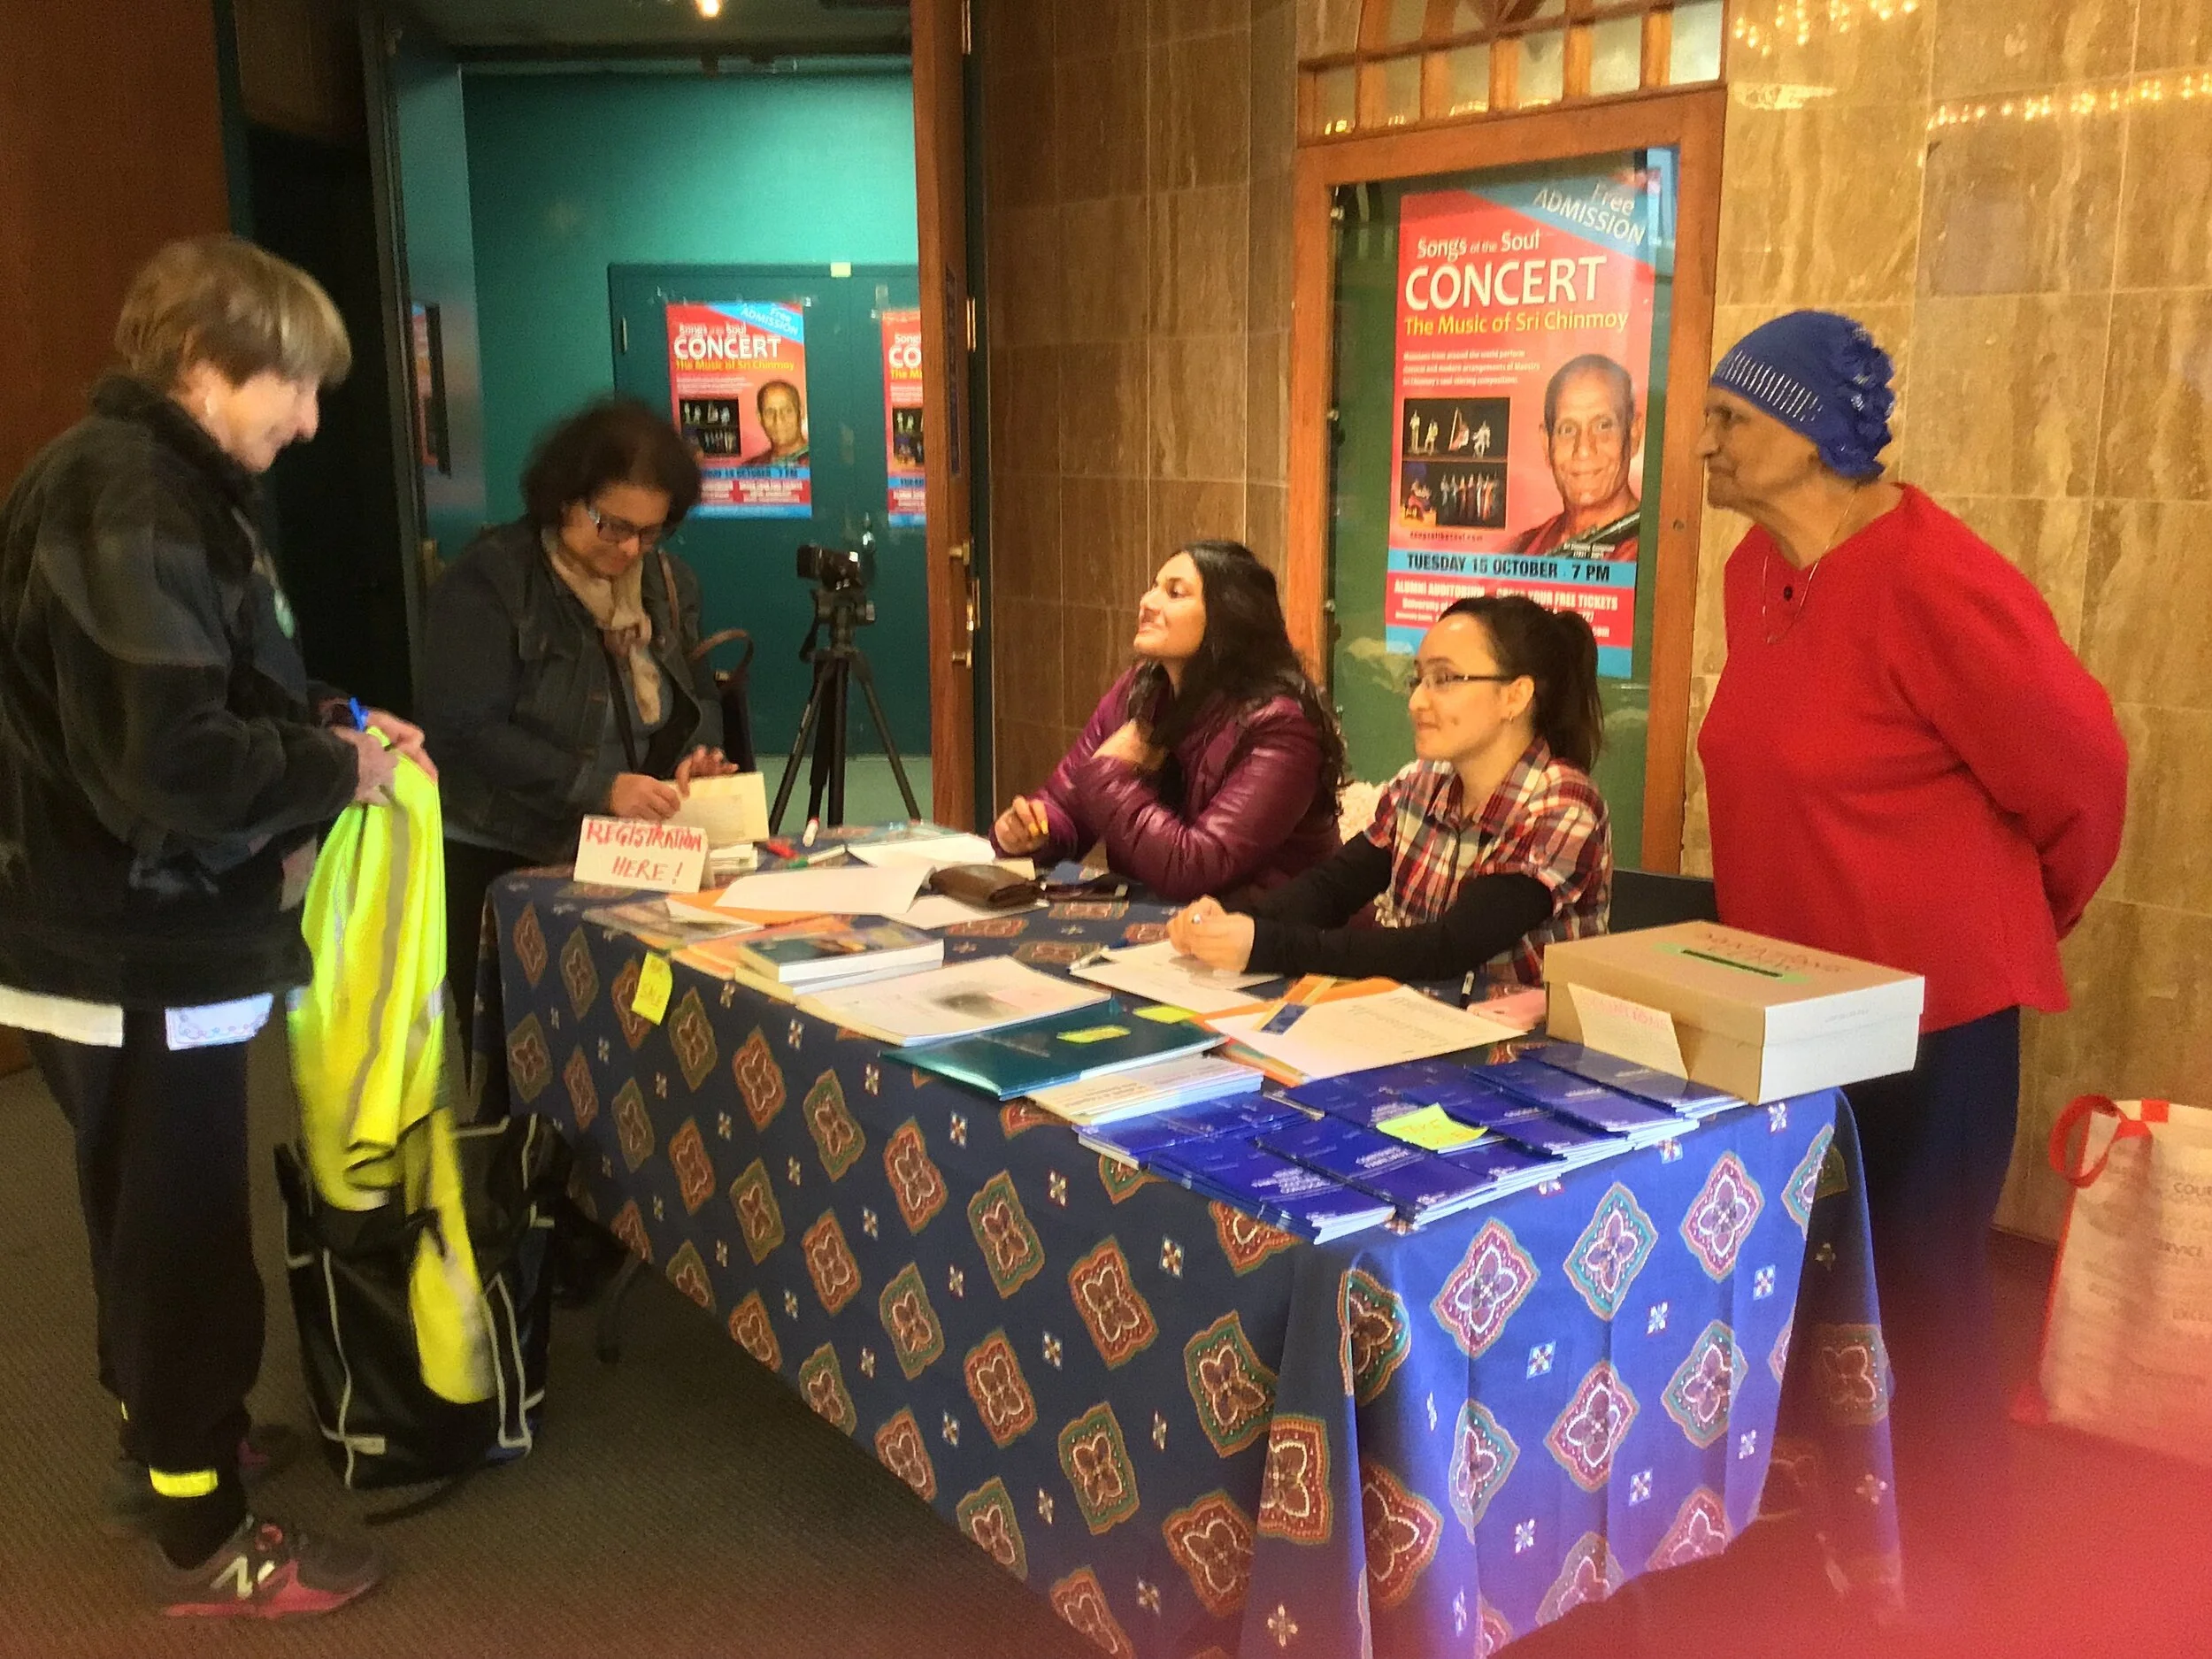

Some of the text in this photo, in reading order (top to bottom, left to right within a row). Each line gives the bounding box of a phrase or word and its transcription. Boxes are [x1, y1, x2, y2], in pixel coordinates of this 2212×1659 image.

[1593, 182, 1635, 216] Free
[1532, 187, 1647, 247] ADMISSION
[1417, 236, 1467, 262] Songs
[1501, 228, 1540, 252] Soul
[1404, 255, 1608, 311] CONCERT
[740, 306, 799, 336] ADMISSION
[1405, 310, 1630, 336] The Music of Sri Chinmoy
[673, 334, 782, 360] CONCERT
[894, 331, 922, 346] Song
[1407, 551, 1610, 583] TUESDAY 15 OCTOBER 7 PM
[1578, 591, 1618, 611] TICKETS
[586, 820, 702, 853] REGISTRATION
